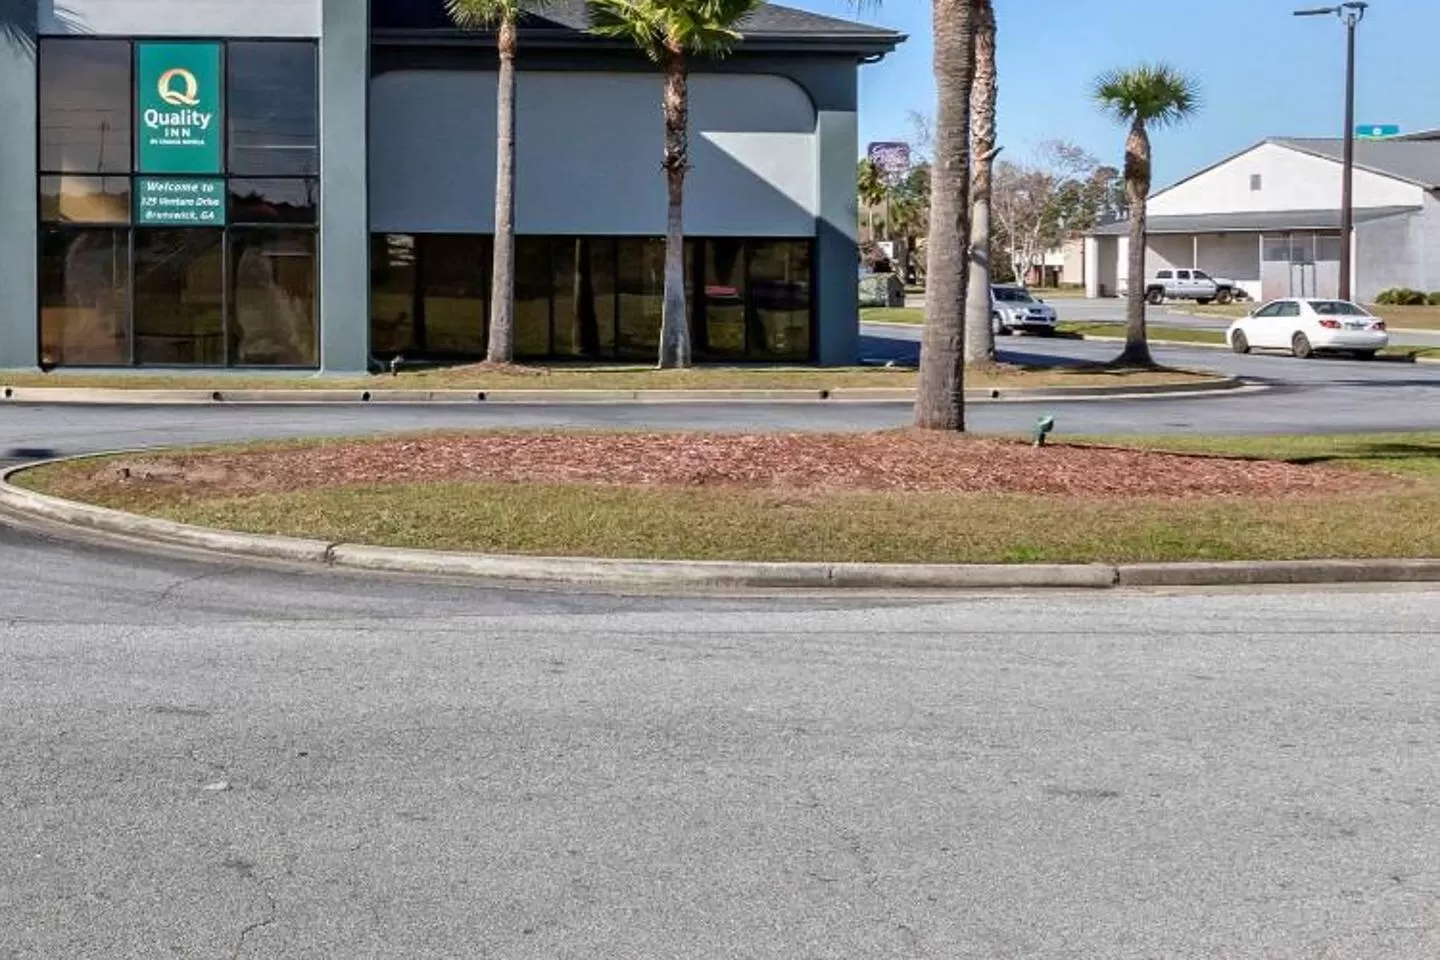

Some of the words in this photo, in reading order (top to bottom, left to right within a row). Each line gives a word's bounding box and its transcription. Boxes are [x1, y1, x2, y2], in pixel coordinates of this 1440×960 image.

[157, 68, 200, 105] Q
[144, 109, 212, 129] Quality
[164, 127, 191, 137] INN
[147, 181, 199, 193] Welcome
[202, 182, 215, 193] to
